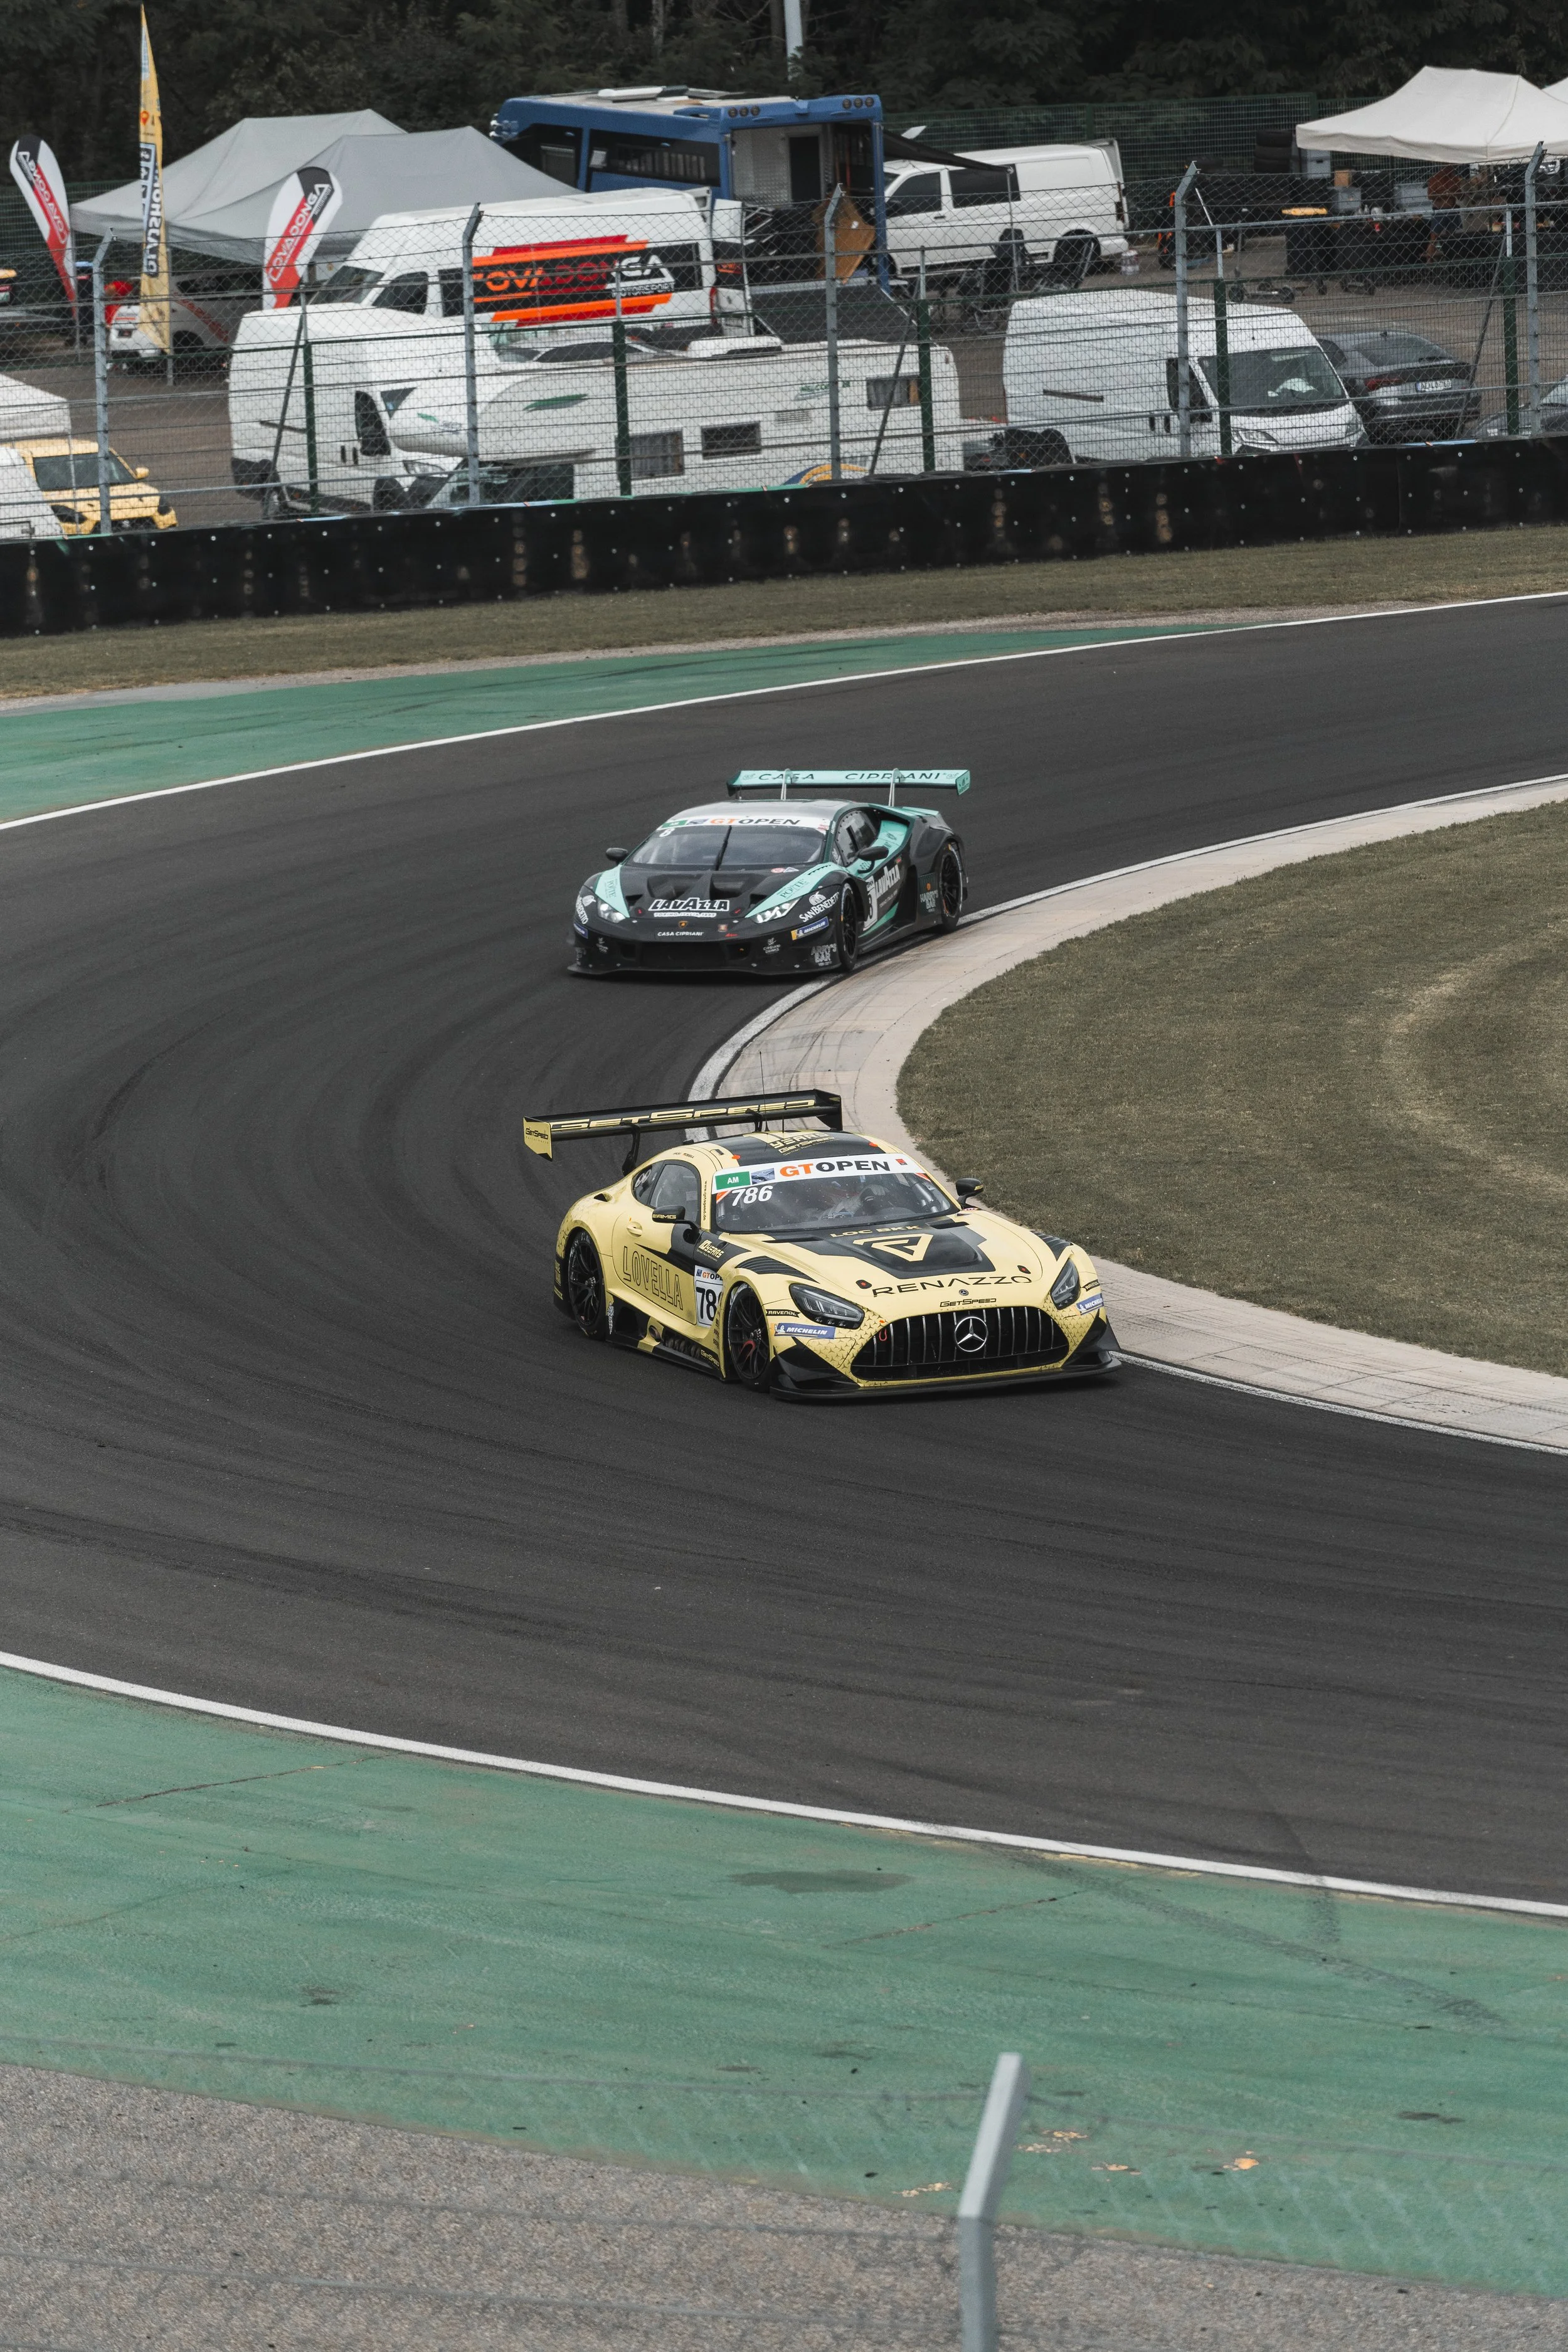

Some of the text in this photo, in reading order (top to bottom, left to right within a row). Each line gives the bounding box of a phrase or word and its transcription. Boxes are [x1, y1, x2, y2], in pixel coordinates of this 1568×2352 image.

[268, 184, 330, 282] COVADONGA
[472, 255, 675, 297] OVADONGA
[659, 828, 675, 837] 8
[648, 897, 730, 911] LAVAZZA
[731, 1185, 774, 1207] 786
[830, 1229, 873, 1238] LOC
[623, 1246, 684, 1311] LOVELLA
[872, 1276, 1032, 1297] RENAZZO
[696, 1286, 723, 1322] 78
